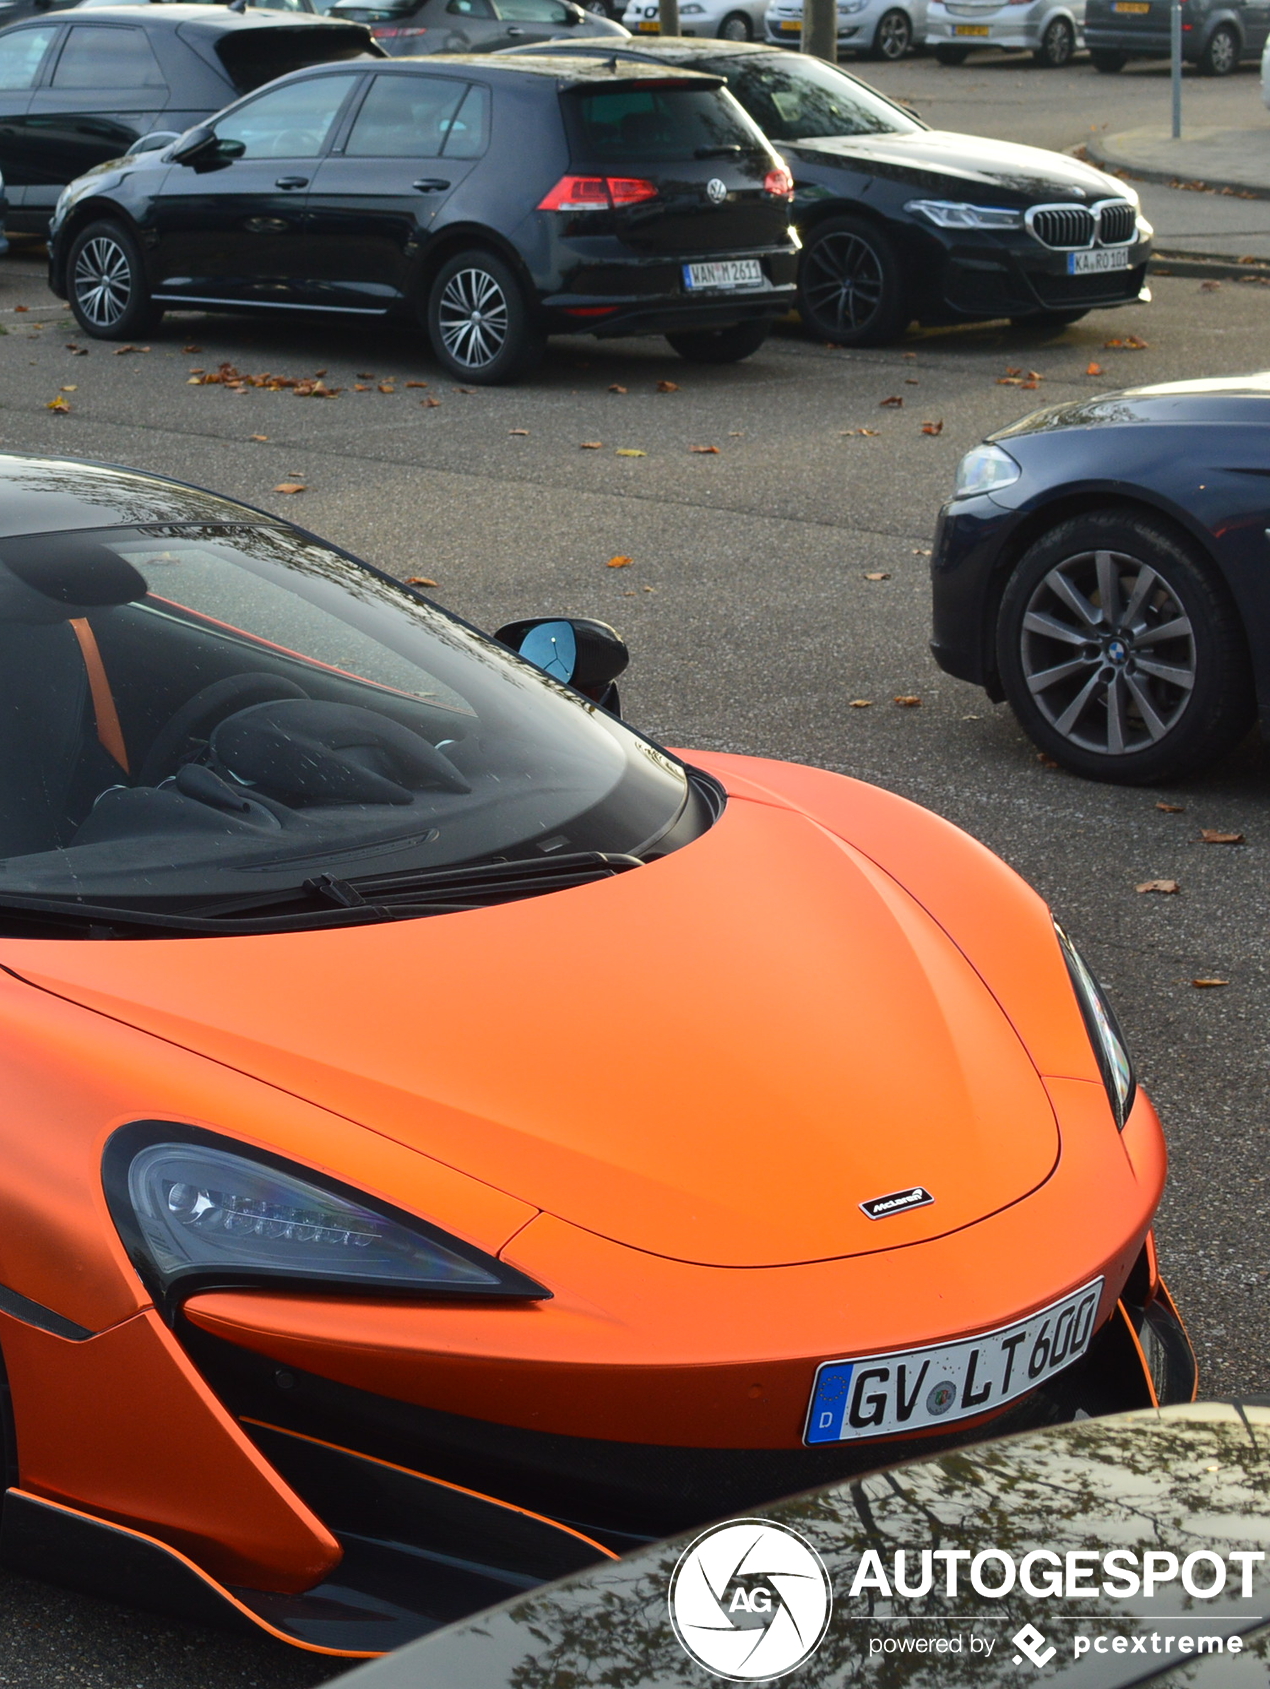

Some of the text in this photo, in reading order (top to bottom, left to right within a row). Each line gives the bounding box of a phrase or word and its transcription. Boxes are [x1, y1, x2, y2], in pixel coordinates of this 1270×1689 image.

[722, 264, 730, 282] M
[731, 261, 760, 280] 2611
[1076, 250, 1126, 271] KA RO 101
[873, 1190, 923, 1213] McLaren
[819, 1292, 1096, 1429] D GV LT 600
